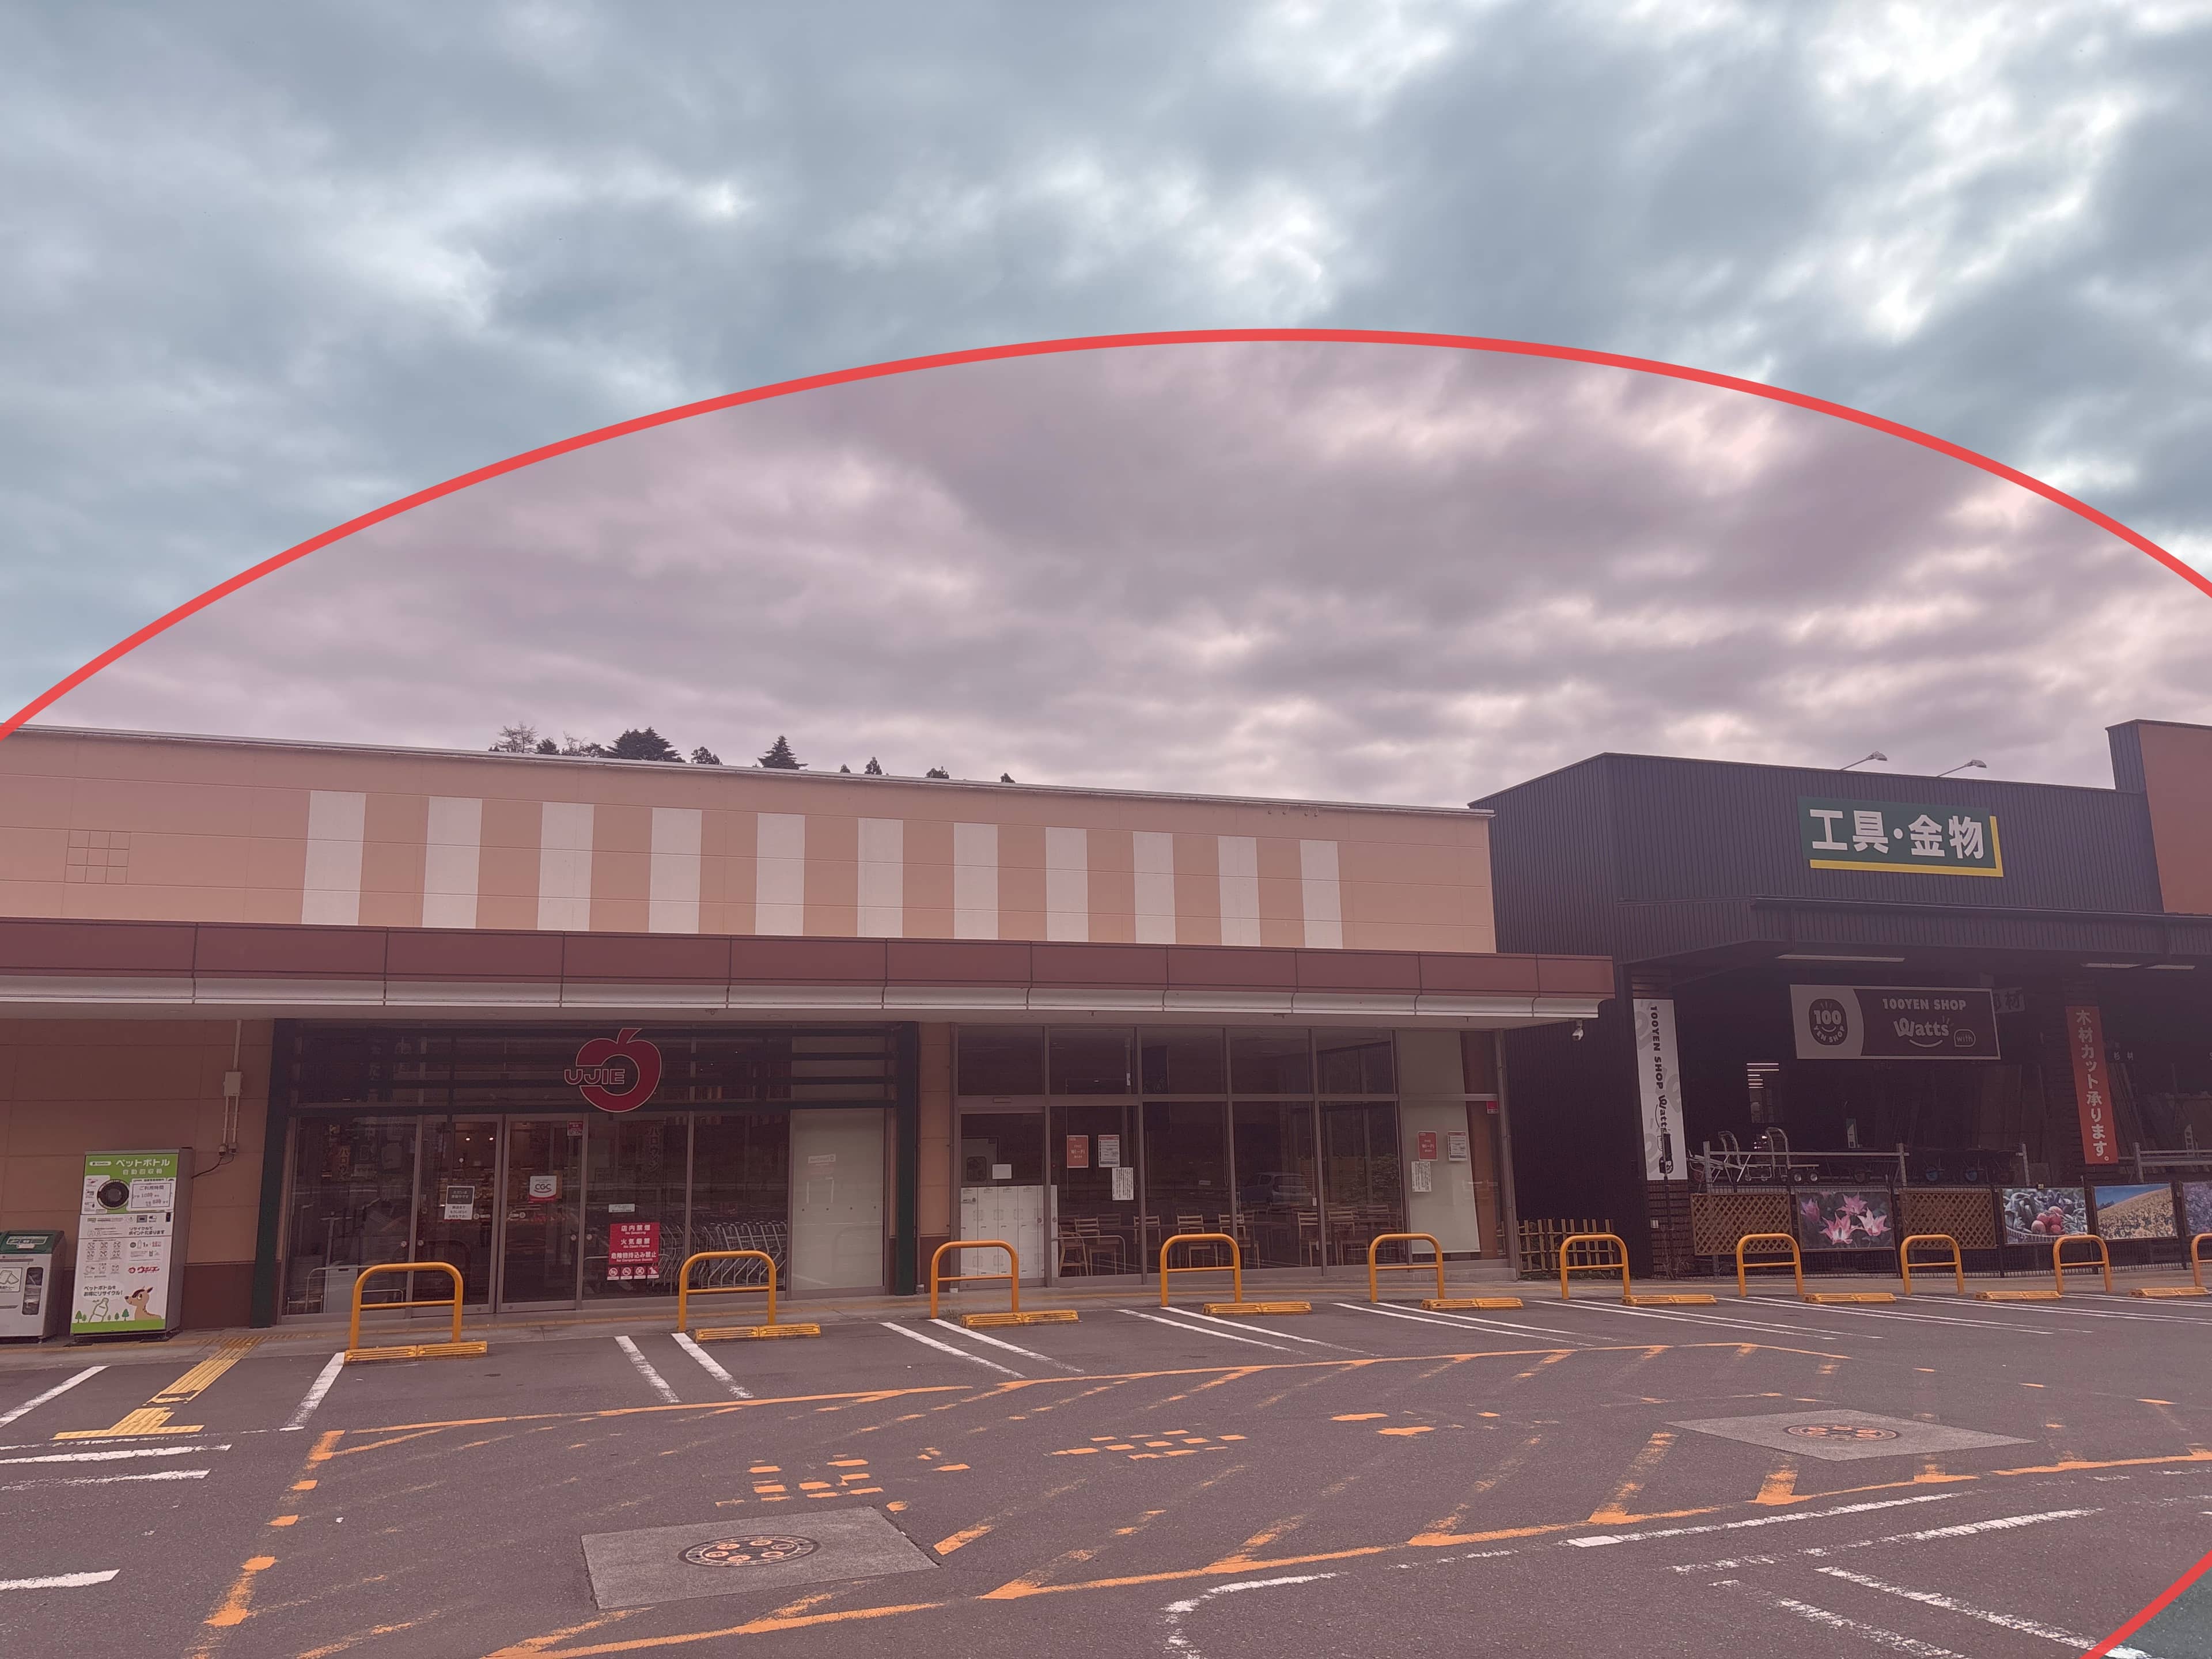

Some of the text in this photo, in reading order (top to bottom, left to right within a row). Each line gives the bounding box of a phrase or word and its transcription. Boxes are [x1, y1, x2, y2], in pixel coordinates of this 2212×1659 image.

[1809, 809, 1984, 859] 工具・金物
[1882, 998, 1967, 1010] 100YEN SHOP
[1813, 1010, 1842, 1025] 100
[1650, 1006, 1661, 1051] 100YEN
[1813, 1025, 1845, 1043] YEN SHOP
[1893, 1017, 1950, 1037] Watts
[1956, 1034, 1974, 1043] with
[564, 1069, 626, 1085] UJIE
[1654, 1056, 1664, 1089] SHOP
[2076, 1010, 2109, 1162] 木材カット承ります。
[116, 1158, 170, 1167] ペットボトル
[621, 1224, 651, 1232] 店内禁煙
[611, 1251, 657, 1259] 危険物持込み禁止
